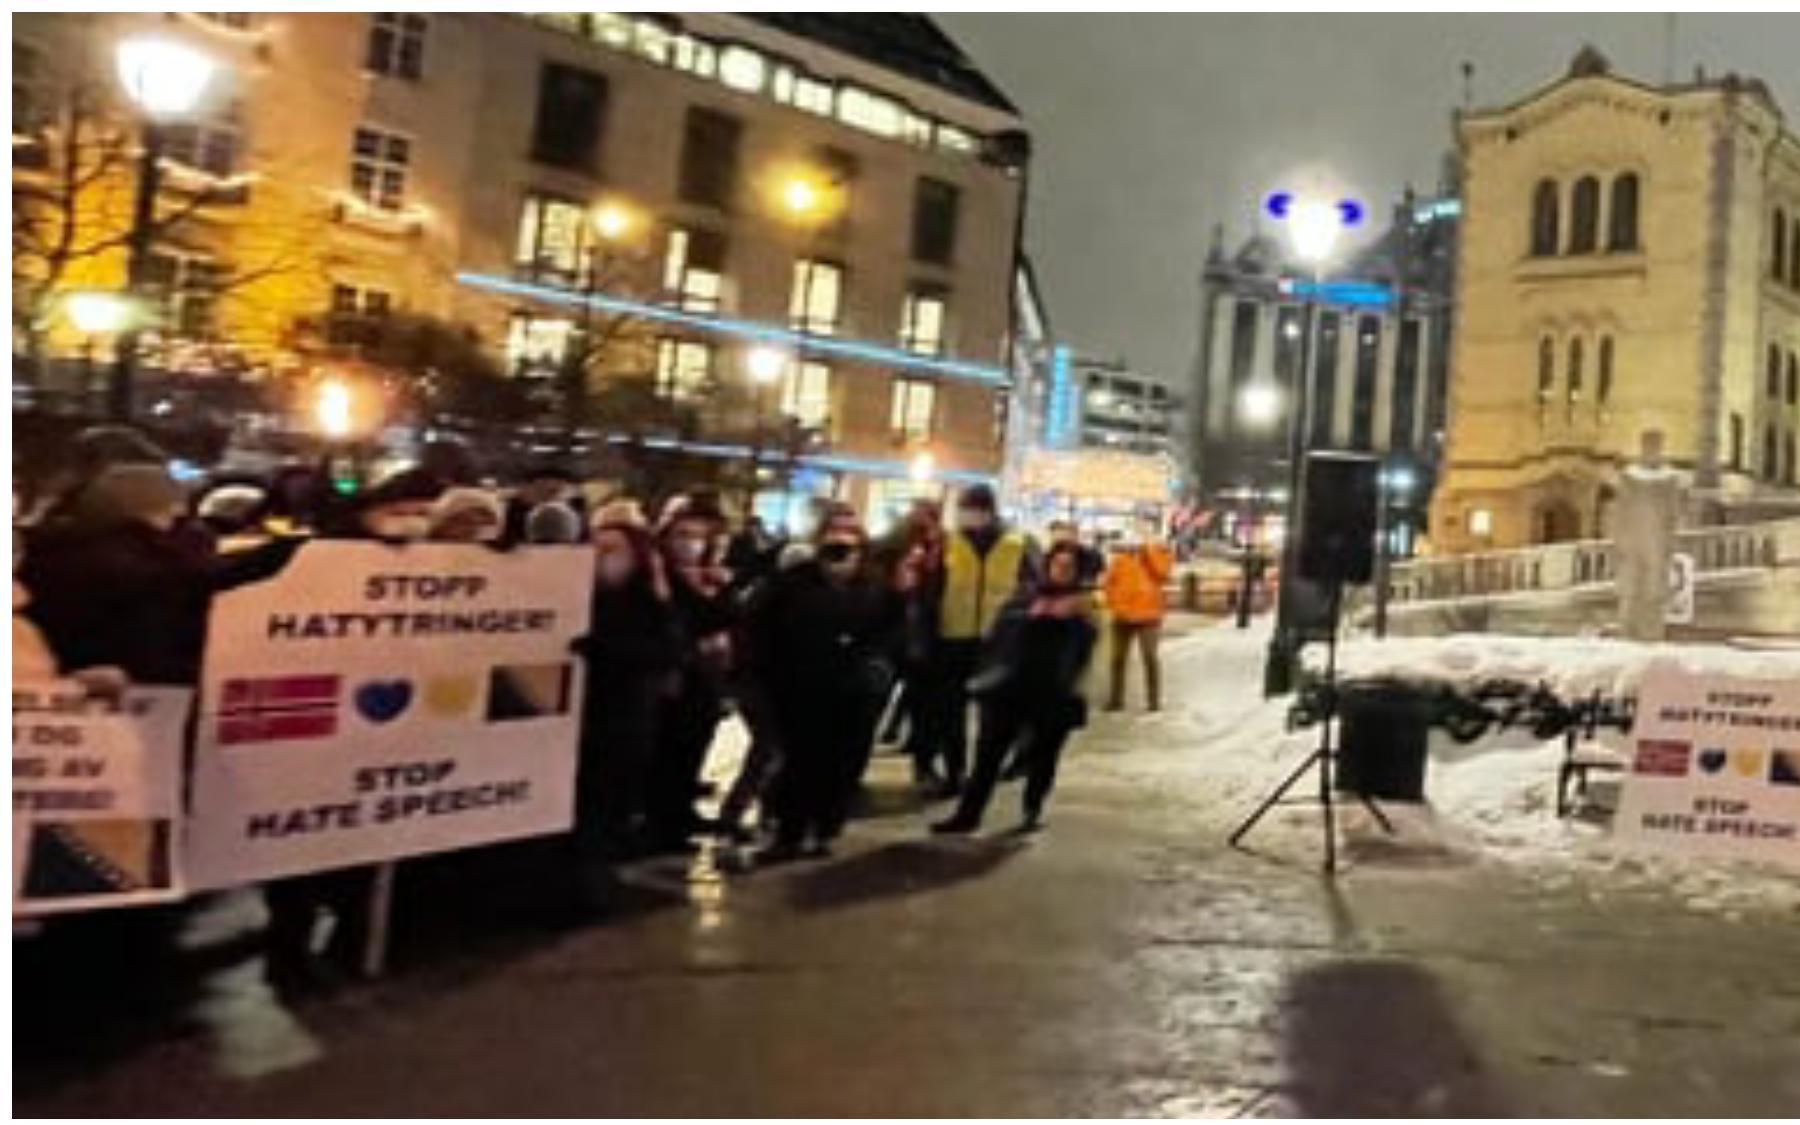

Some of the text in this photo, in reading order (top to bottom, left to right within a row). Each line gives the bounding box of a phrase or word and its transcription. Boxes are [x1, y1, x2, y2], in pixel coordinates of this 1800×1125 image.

[365, 574, 488, 600] STOPP
[354, 757, 456, 792] STOP
[246, 779, 530, 838] HATE SPEECH!
